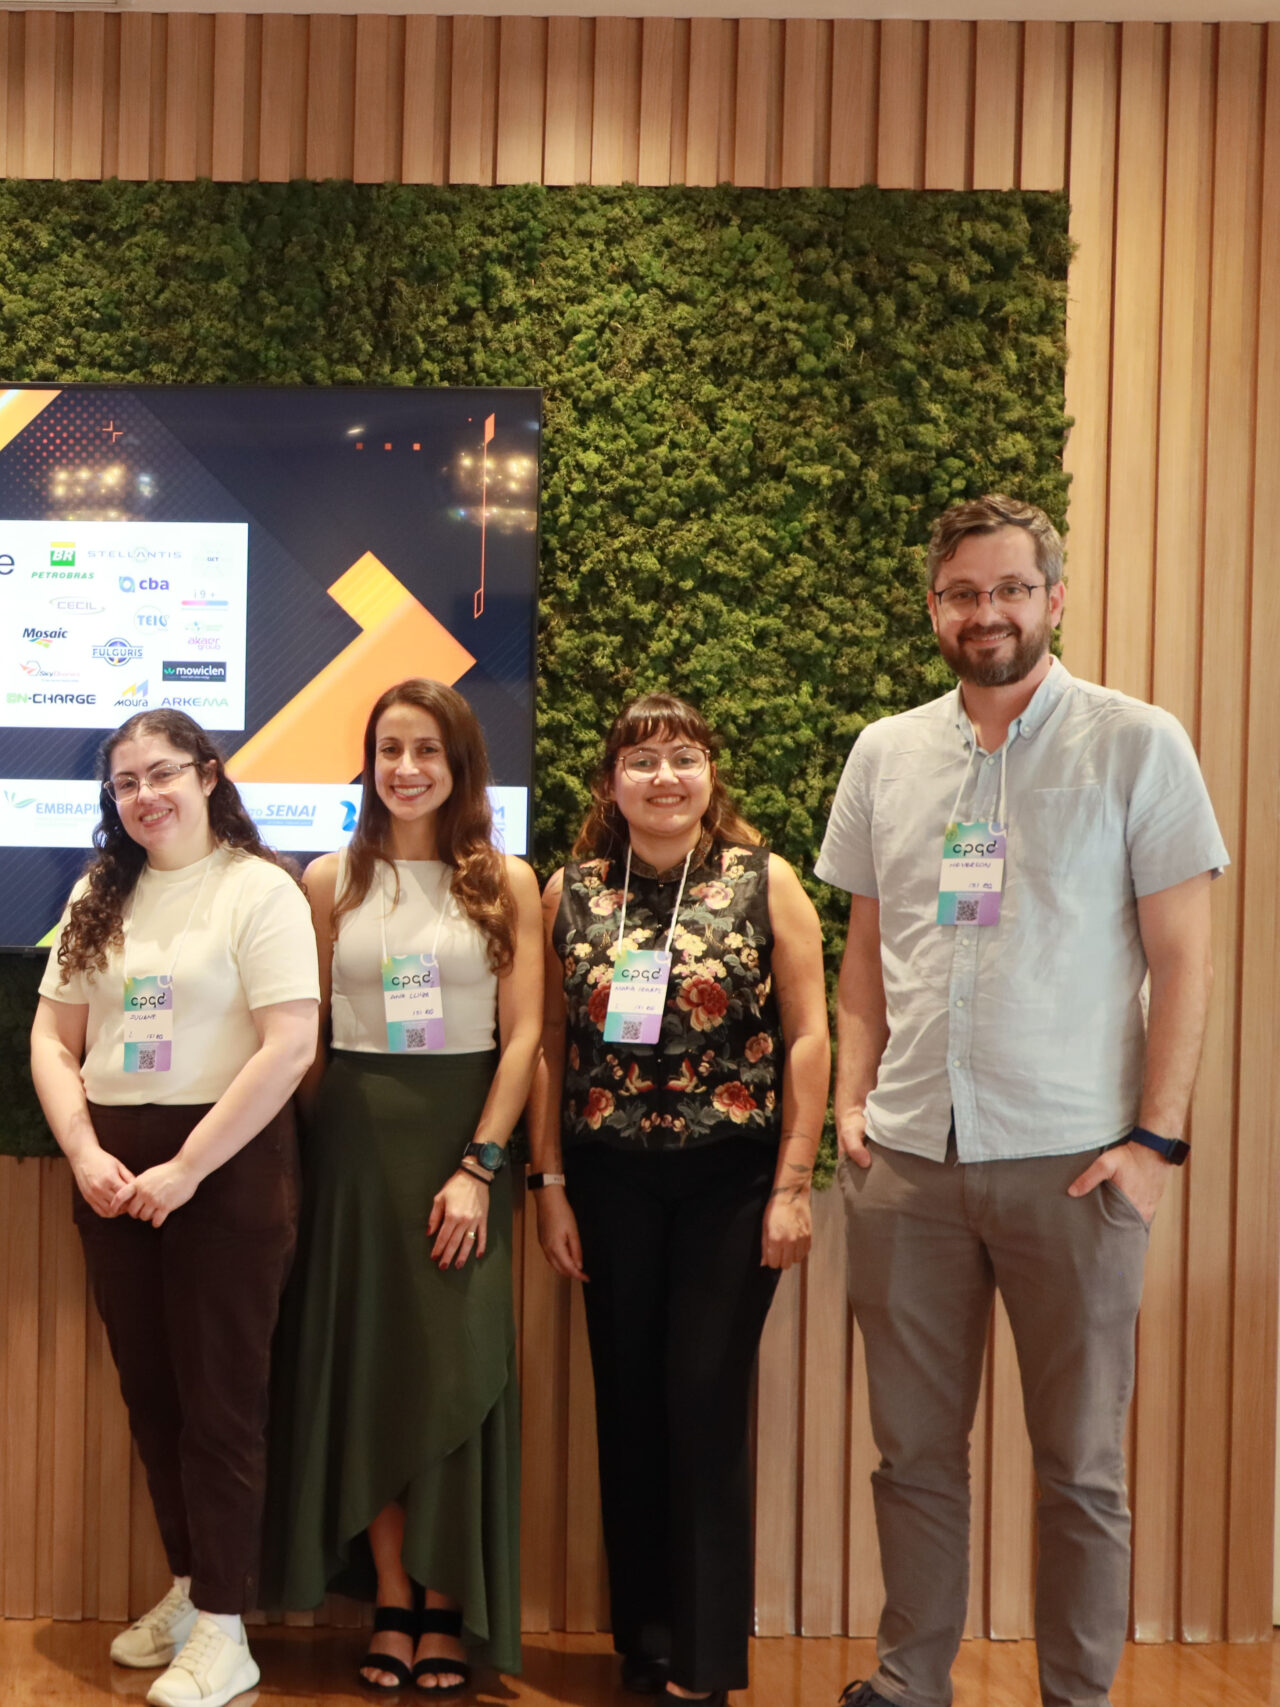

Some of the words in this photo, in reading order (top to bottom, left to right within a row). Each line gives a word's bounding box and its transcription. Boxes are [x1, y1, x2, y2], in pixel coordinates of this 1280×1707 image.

[88, 550, 181, 559] STELLANTIS
[31, 571, 95, 580] PETROBRAS
[139, 577, 170, 591] cba
[57, 601, 97, 610] CECIL
[22, 627, 68, 639] Mosaic
[92, 647, 143, 658] FULGURIS
[161, 697, 229, 707] ARKEMA
[265, 804, 317, 817] SENAI
